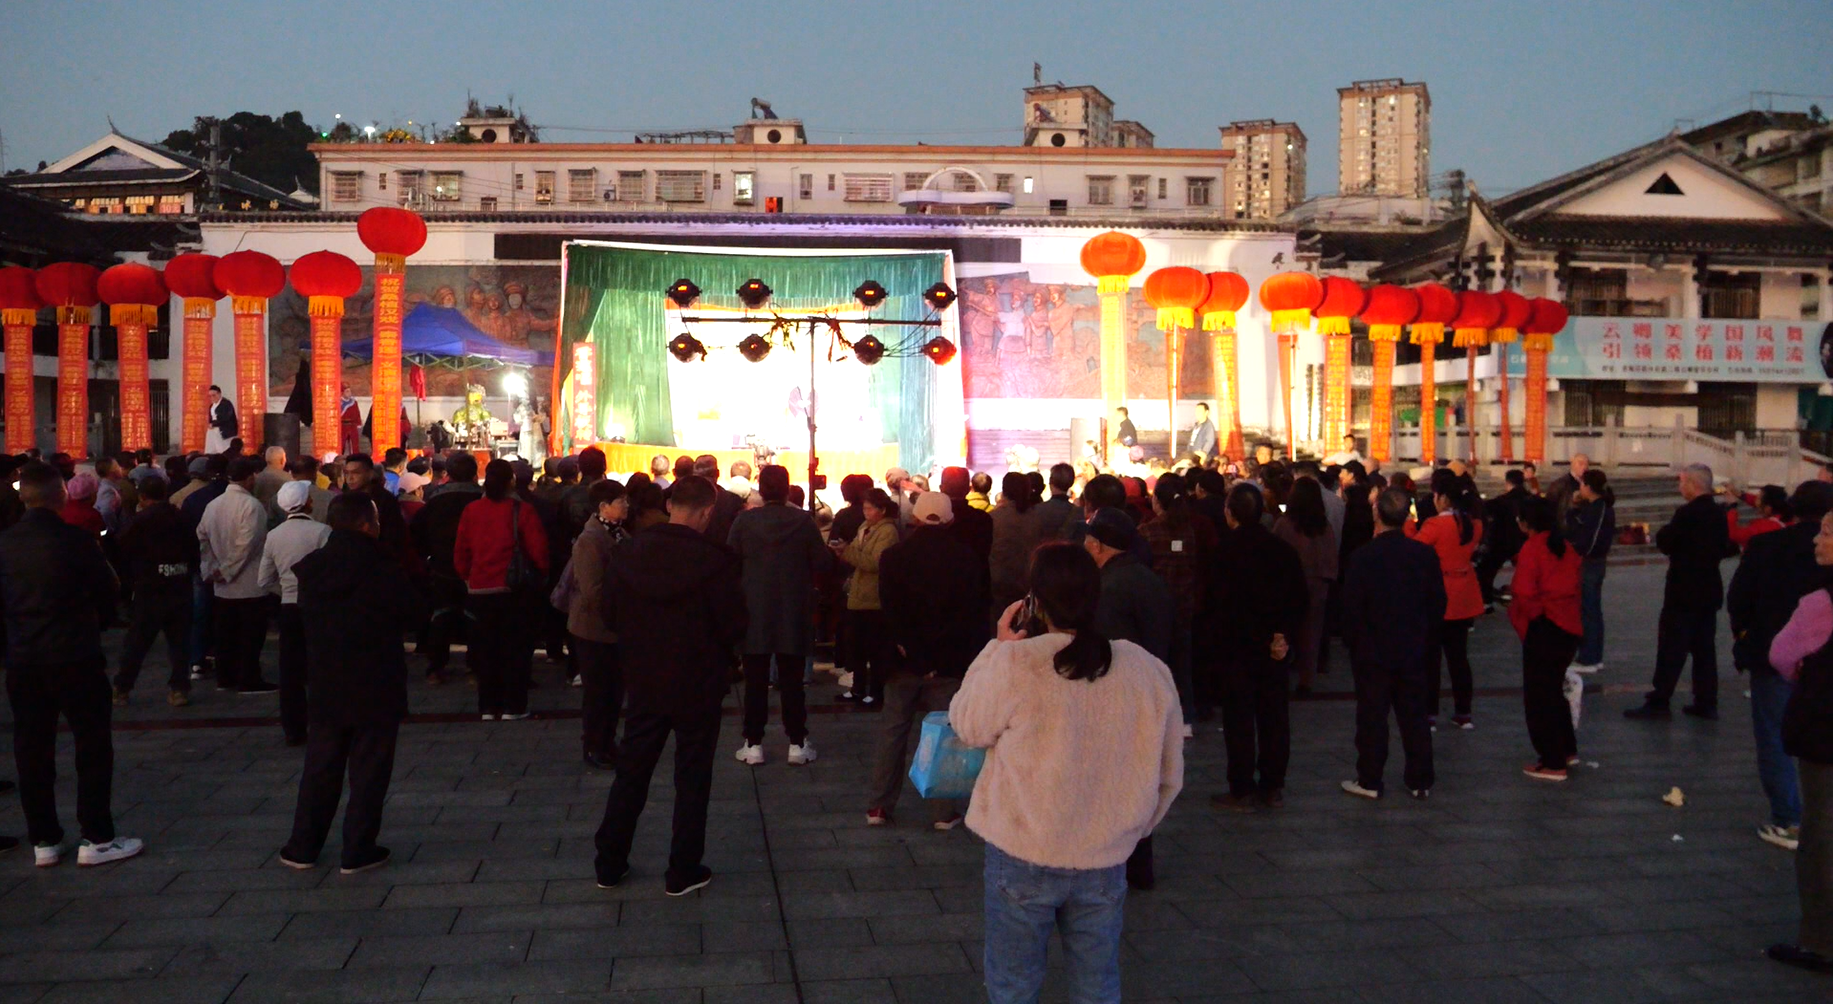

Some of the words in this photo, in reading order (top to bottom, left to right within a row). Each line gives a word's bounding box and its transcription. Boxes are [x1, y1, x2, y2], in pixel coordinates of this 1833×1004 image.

[1603, 343, 1803, 362] 引领桑植新潮流
